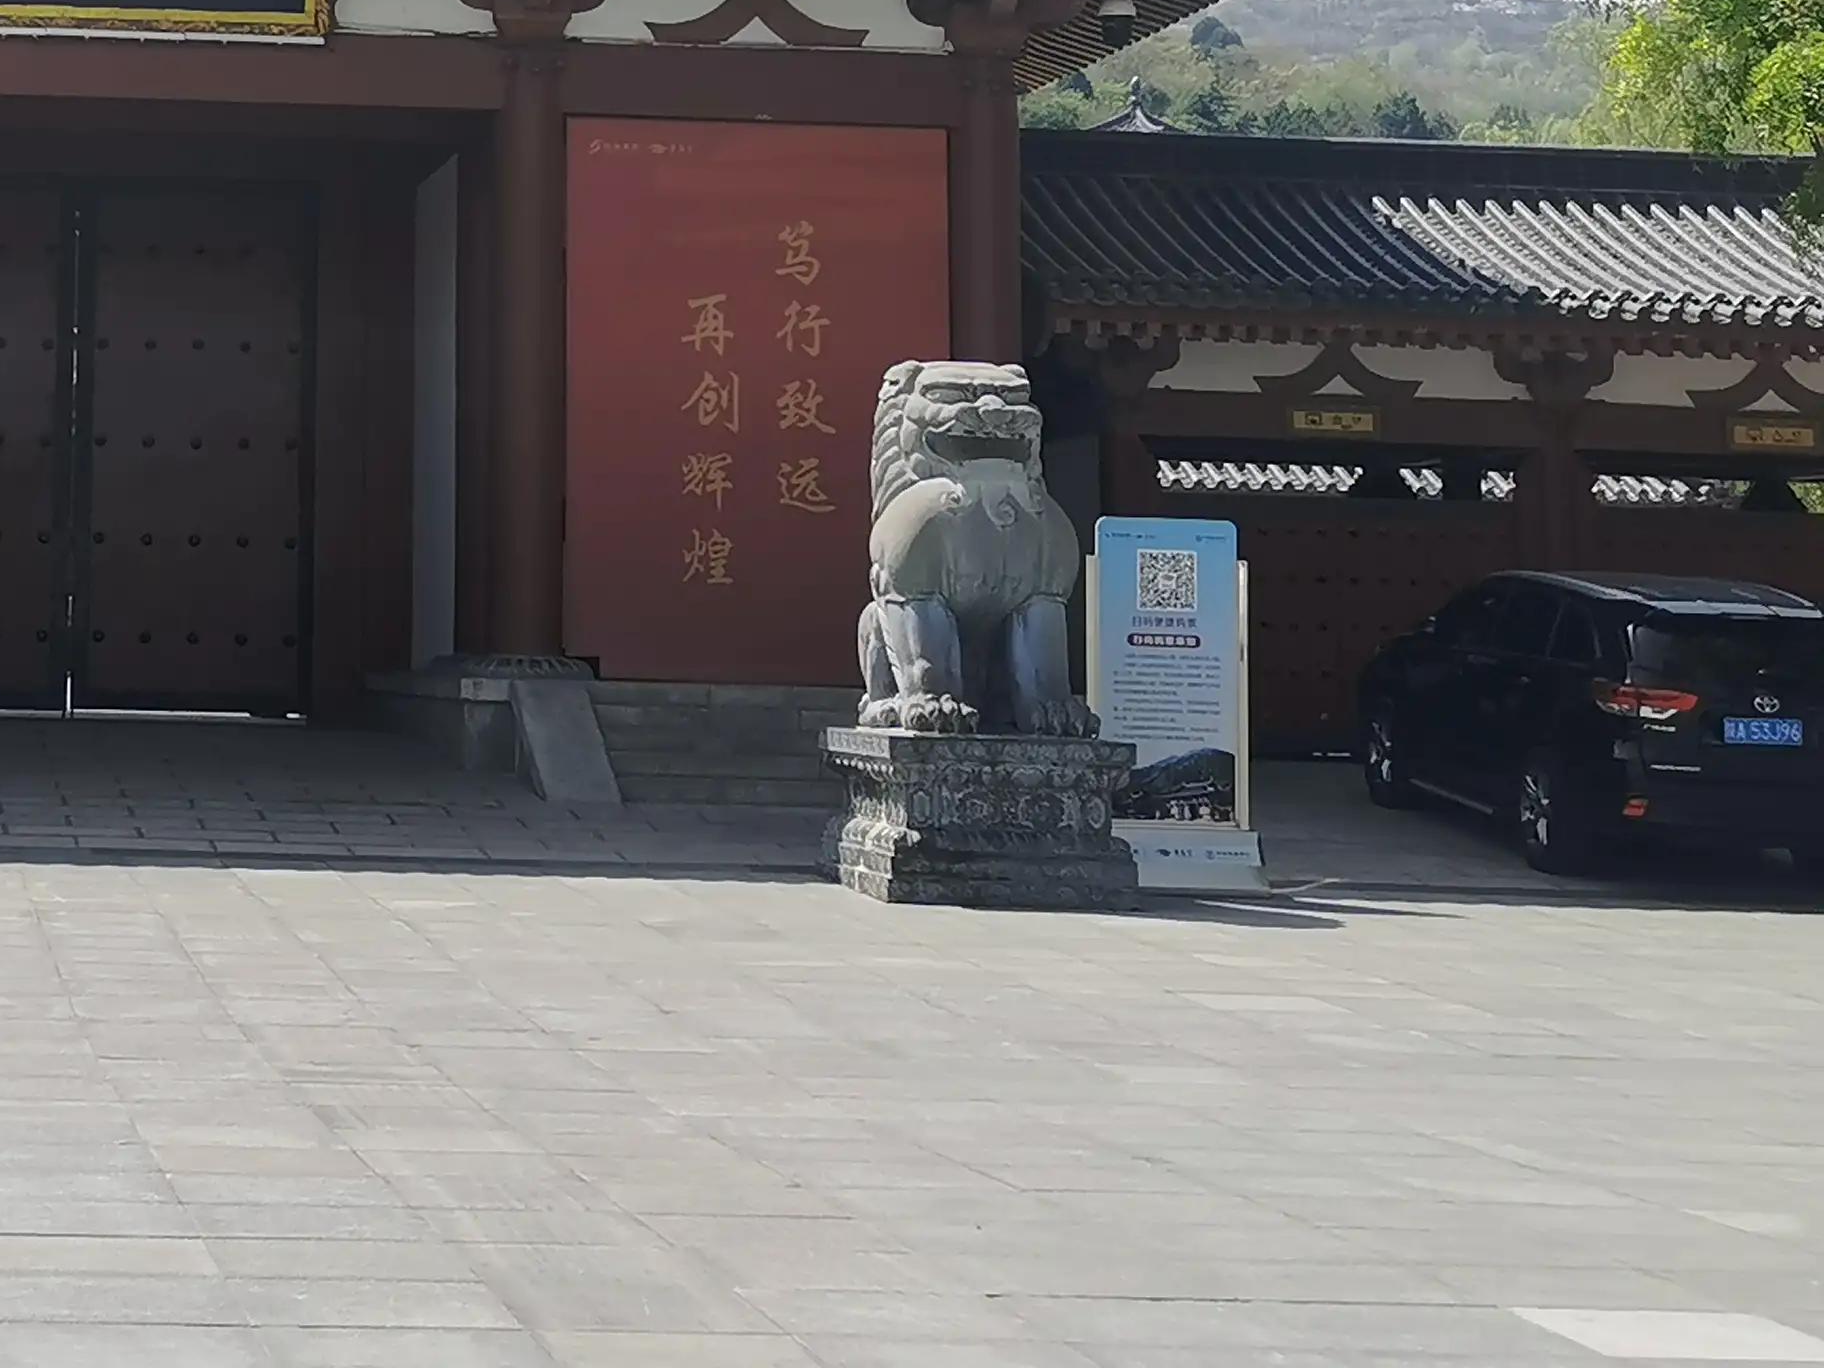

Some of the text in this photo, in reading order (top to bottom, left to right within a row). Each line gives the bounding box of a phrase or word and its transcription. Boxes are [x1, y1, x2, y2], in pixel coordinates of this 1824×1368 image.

[680, 293, 740, 585] 再创辉煌
[774, 219, 837, 513] 笃行致远
